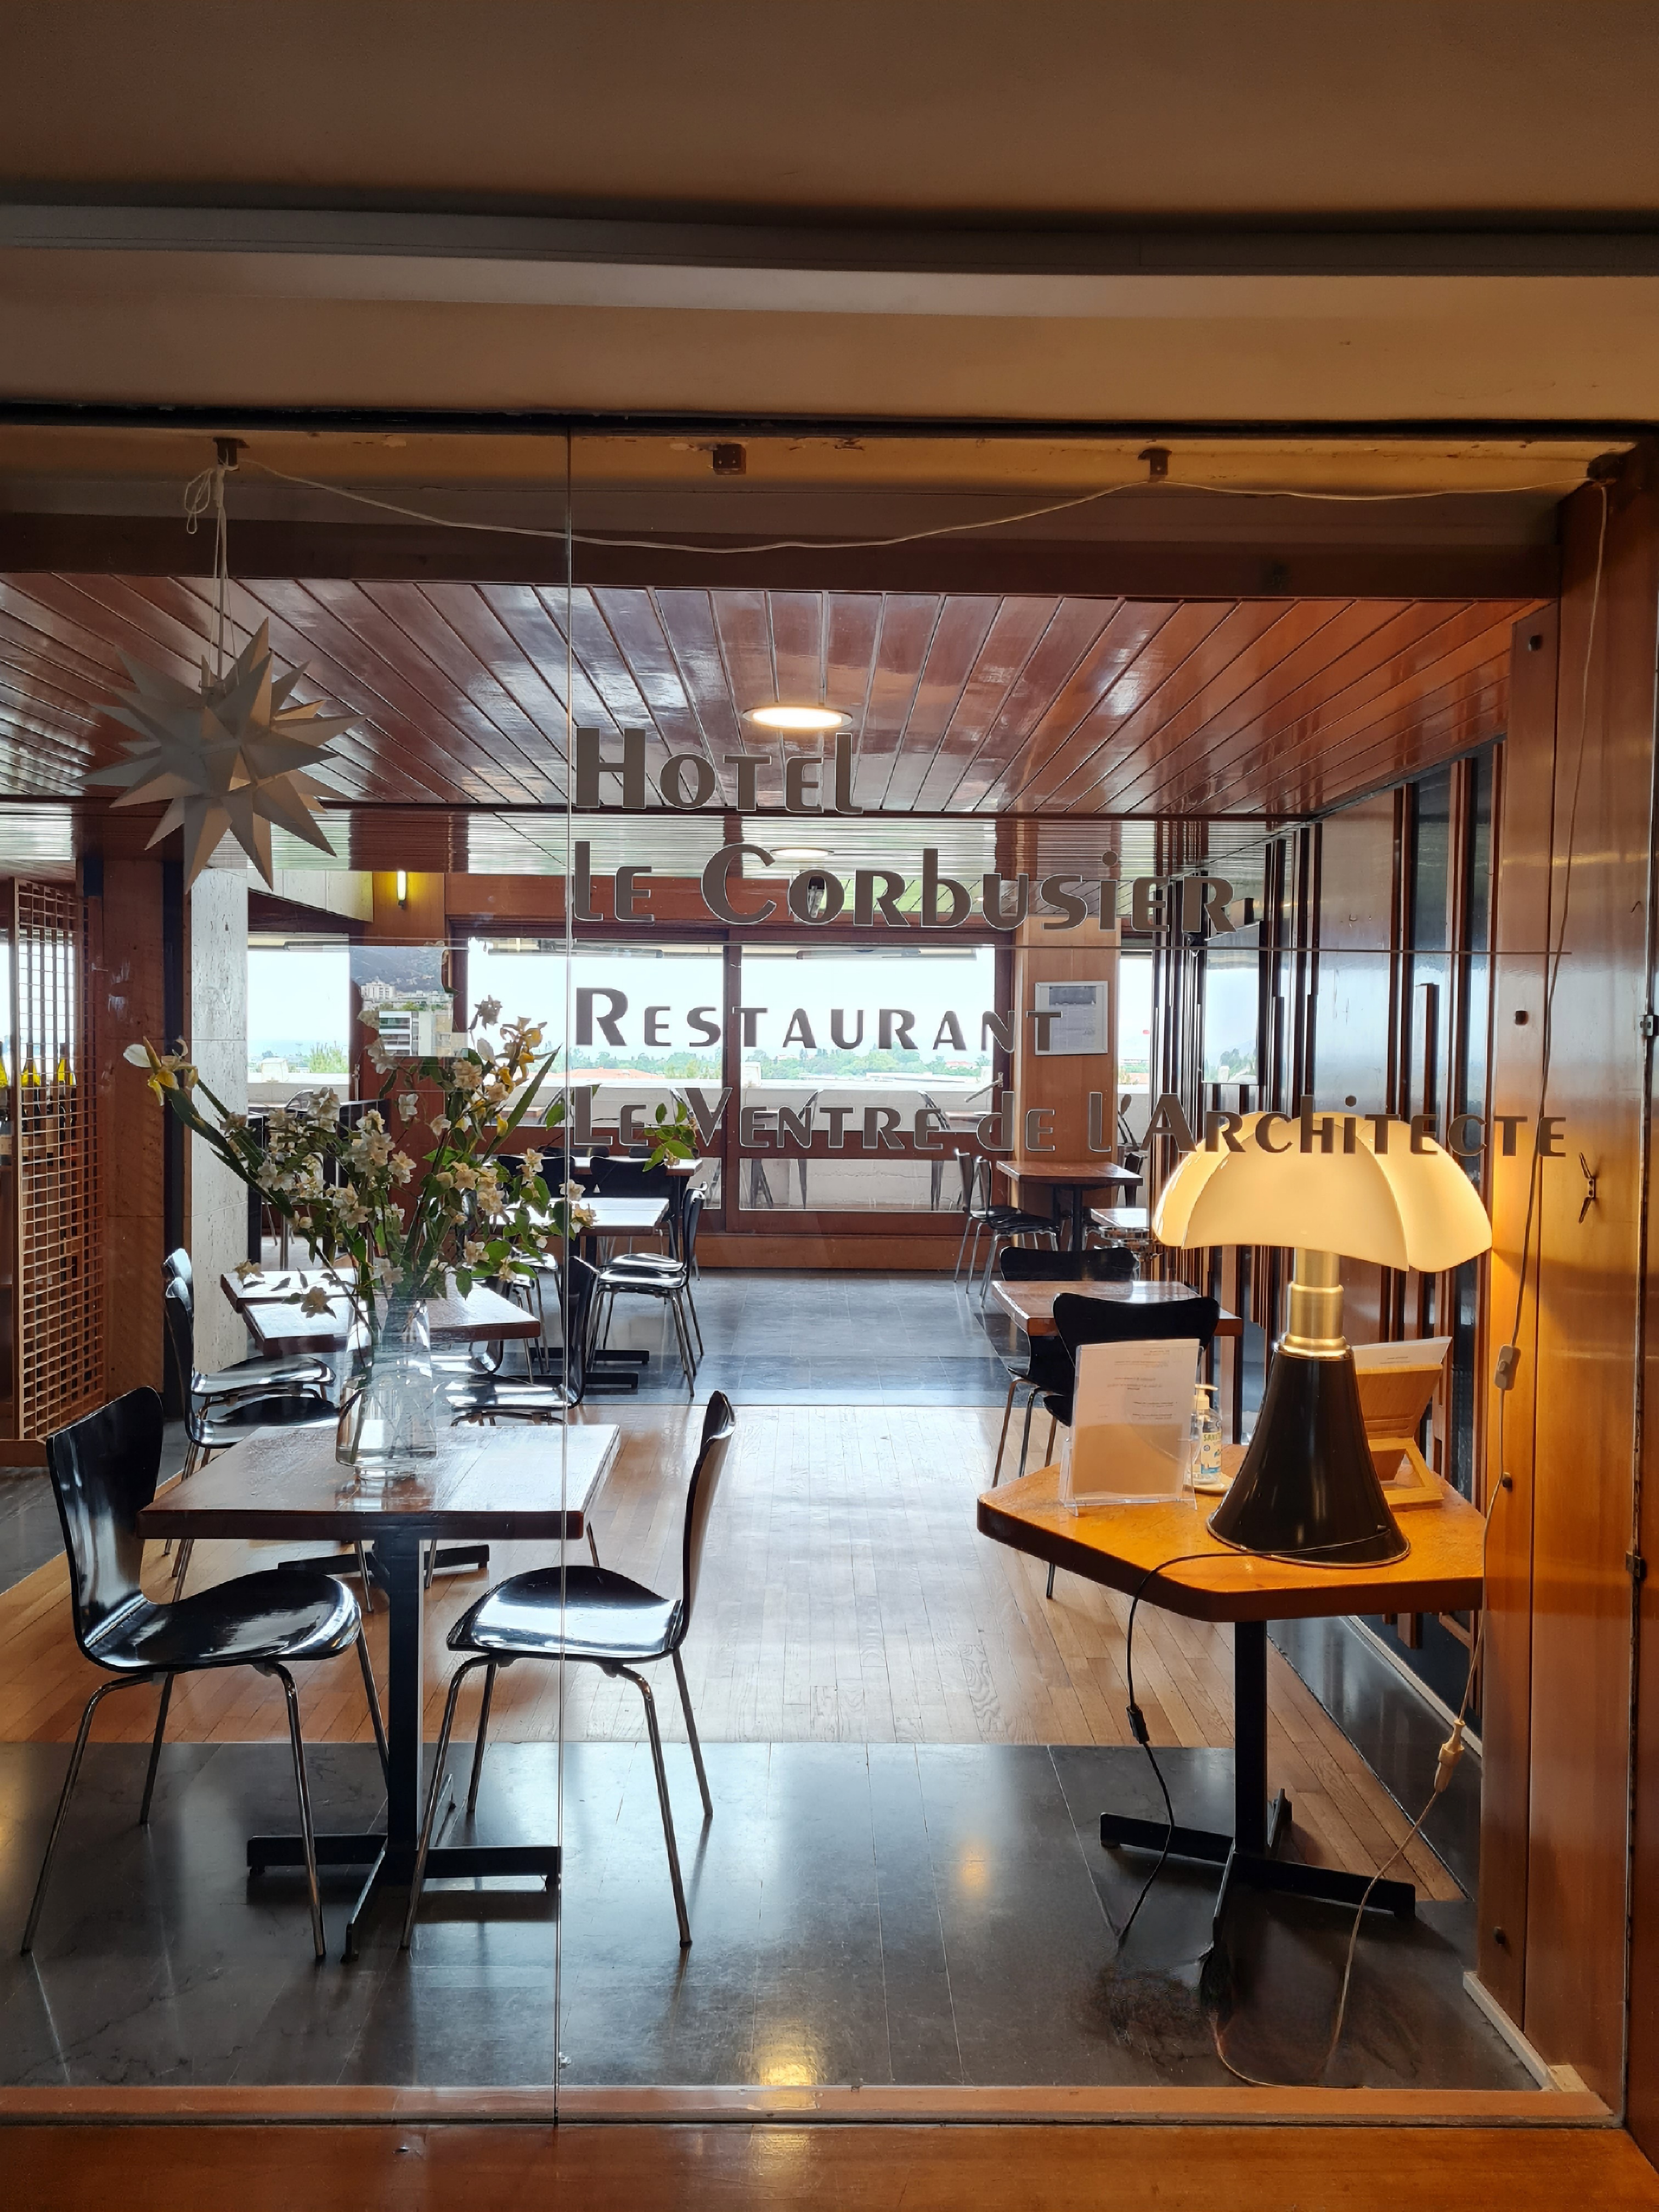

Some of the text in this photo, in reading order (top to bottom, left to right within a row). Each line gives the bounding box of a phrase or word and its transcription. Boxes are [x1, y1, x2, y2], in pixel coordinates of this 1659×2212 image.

[575, 987, 1063, 1053] RESTAURANT
[573, 1086, 650, 1147] LE
[685, 1087, 944, 1150] VENTRE
